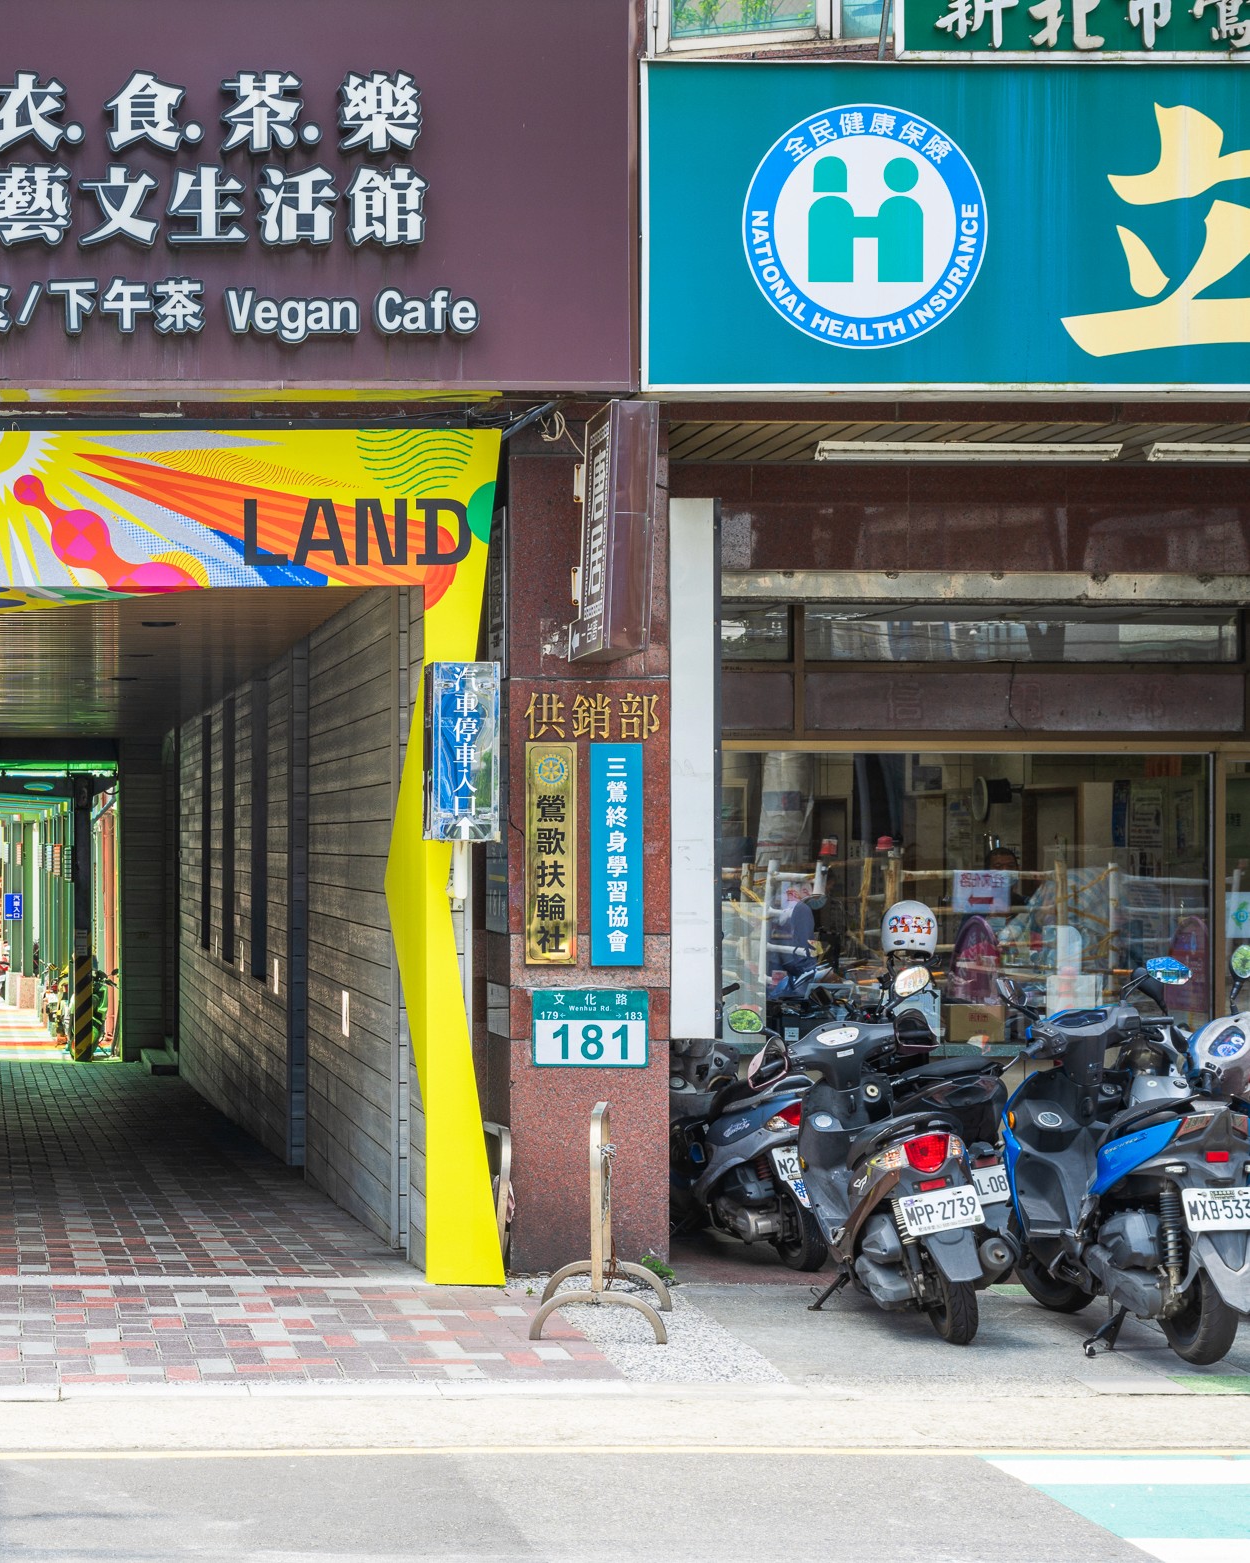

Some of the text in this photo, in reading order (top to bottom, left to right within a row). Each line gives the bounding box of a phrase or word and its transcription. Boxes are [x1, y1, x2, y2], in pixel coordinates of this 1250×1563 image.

[783, 110, 953, 166] 全民健康保險
[750, 202, 980, 341] NATIONAL HEALTH INSURANCE
[226, 288, 359, 343] Vegan
[375, 288, 480, 334] Cafe
[243, 498, 472, 567] LAND
[451, 667, 479, 817] 汽車停車入口
[524, 691, 661, 740] 供銷部
[536, 793, 566, 954] 鶯歌扶輪社
[605, 756, 629, 953] 三鶯終身學習協會
[13, 895, 21, 919] 汽車入口
[540, 1011, 559, 1020] 179
[553, 993, 628, 1006] 文化路
[624, 1011, 643, 1020] 183
[552, 1023, 629, 1061] 181
